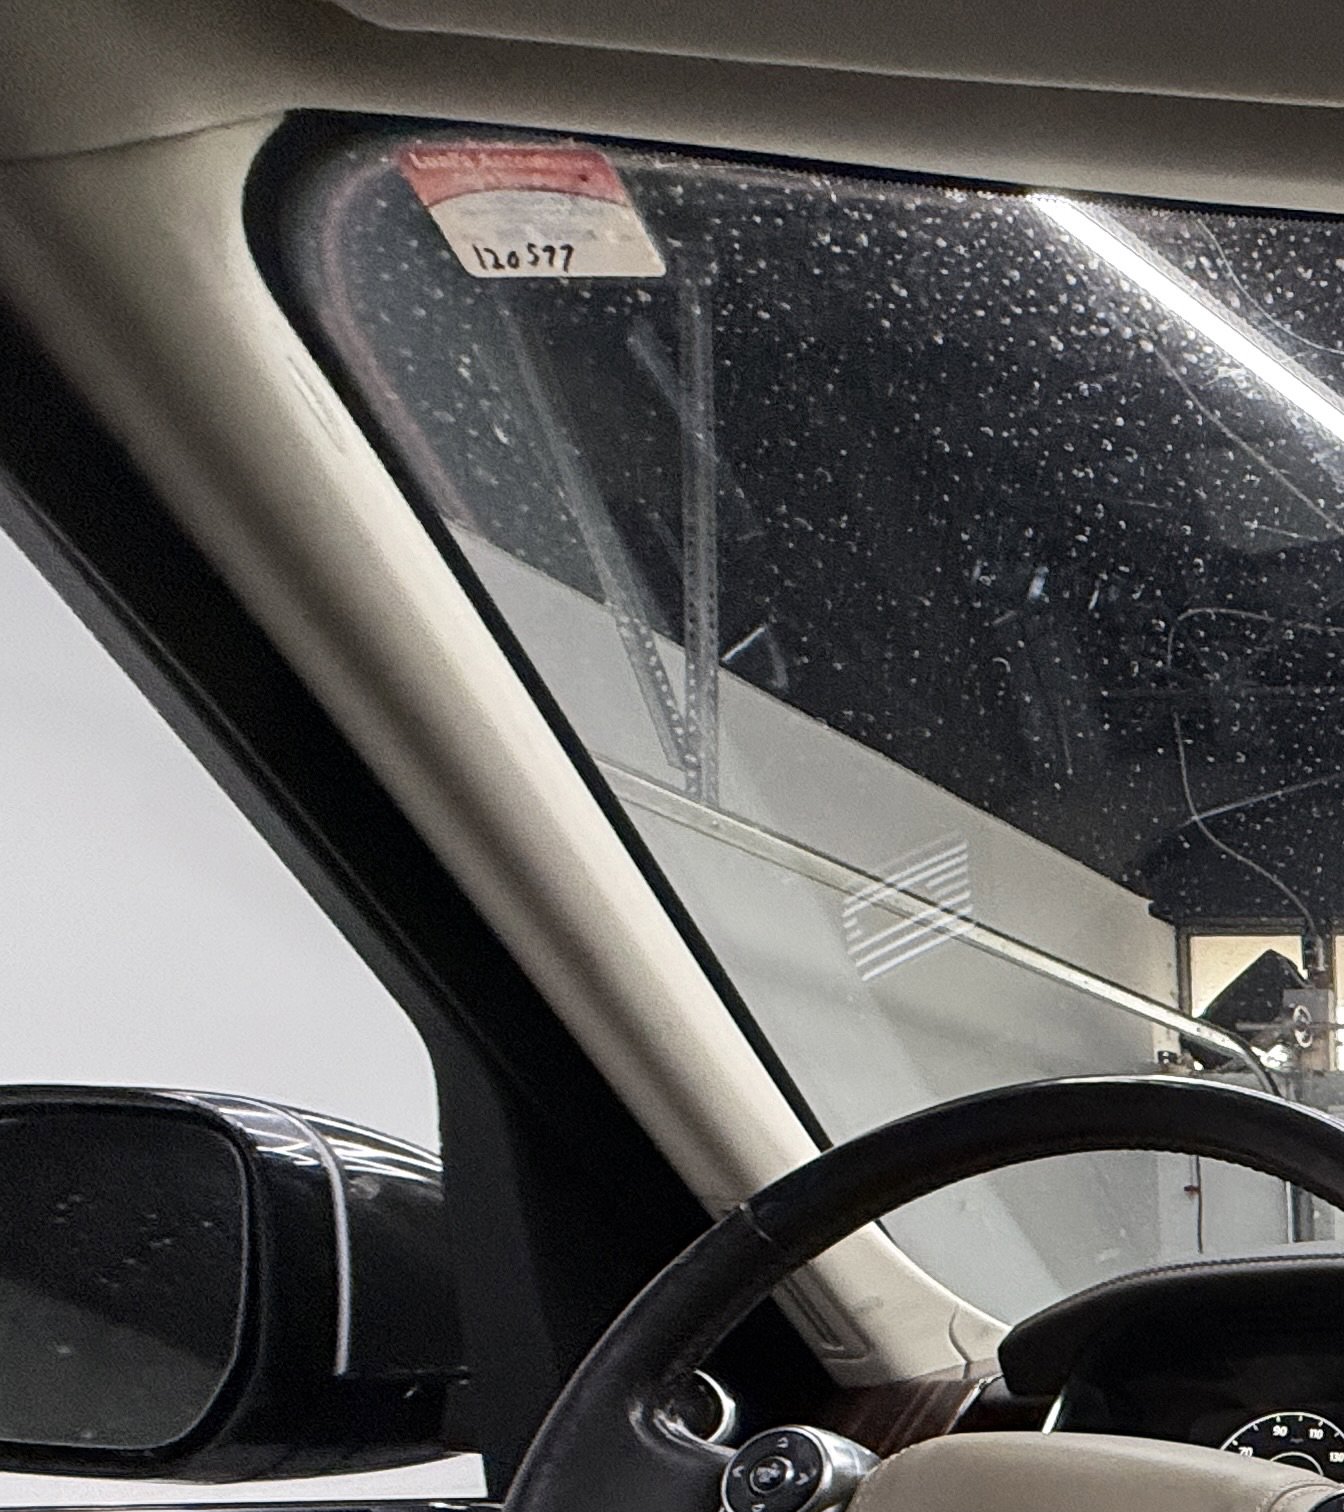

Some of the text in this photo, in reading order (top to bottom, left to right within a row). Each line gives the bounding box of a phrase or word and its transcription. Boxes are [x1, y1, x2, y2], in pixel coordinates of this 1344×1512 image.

[1273, 1426, 1288, 1437] 90
[1309, 1428, 1324, 1440] 110
[1238, 1446, 1253, 1457] 70
[1329, 1451, 1344, 1463] 130
